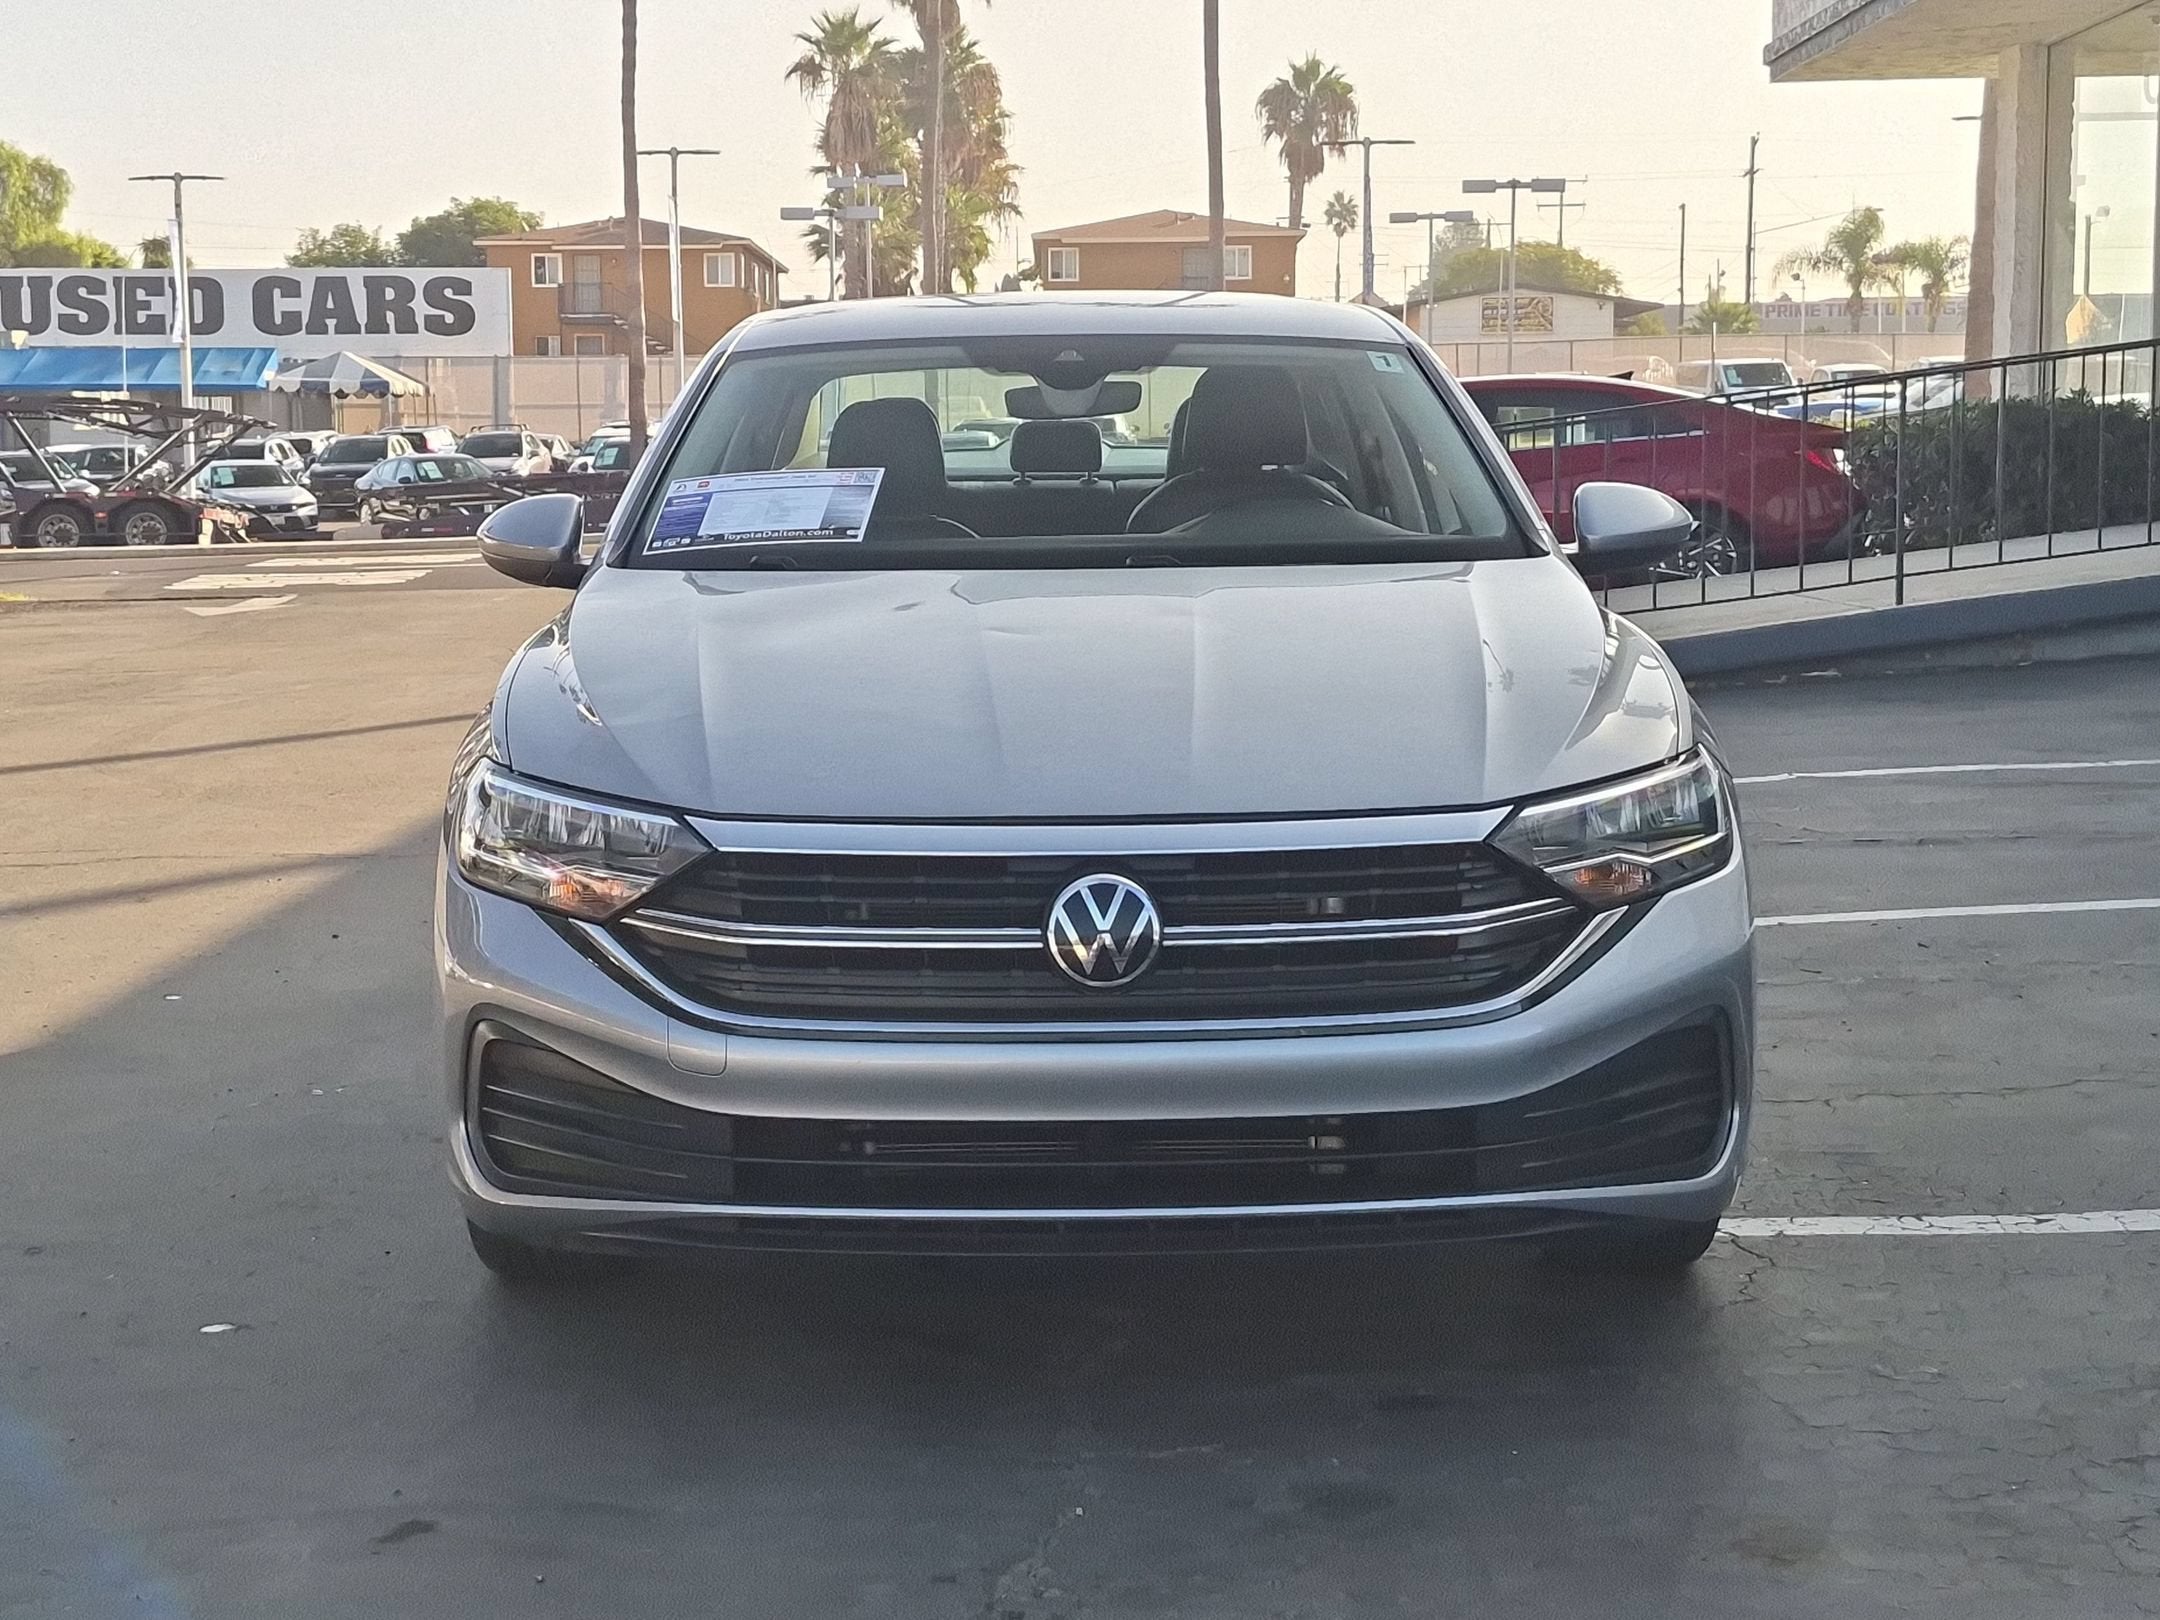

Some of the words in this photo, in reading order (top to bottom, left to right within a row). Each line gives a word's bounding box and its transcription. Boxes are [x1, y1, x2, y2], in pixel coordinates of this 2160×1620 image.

[0, 275, 224, 336] USED
[252, 275, 476, 336] CARS
[1765, 303, 1822, 318] PRIME
[722, 528, 834, 541] ToyotaDalton.com
[1047, 873, 1160, 987] VW
